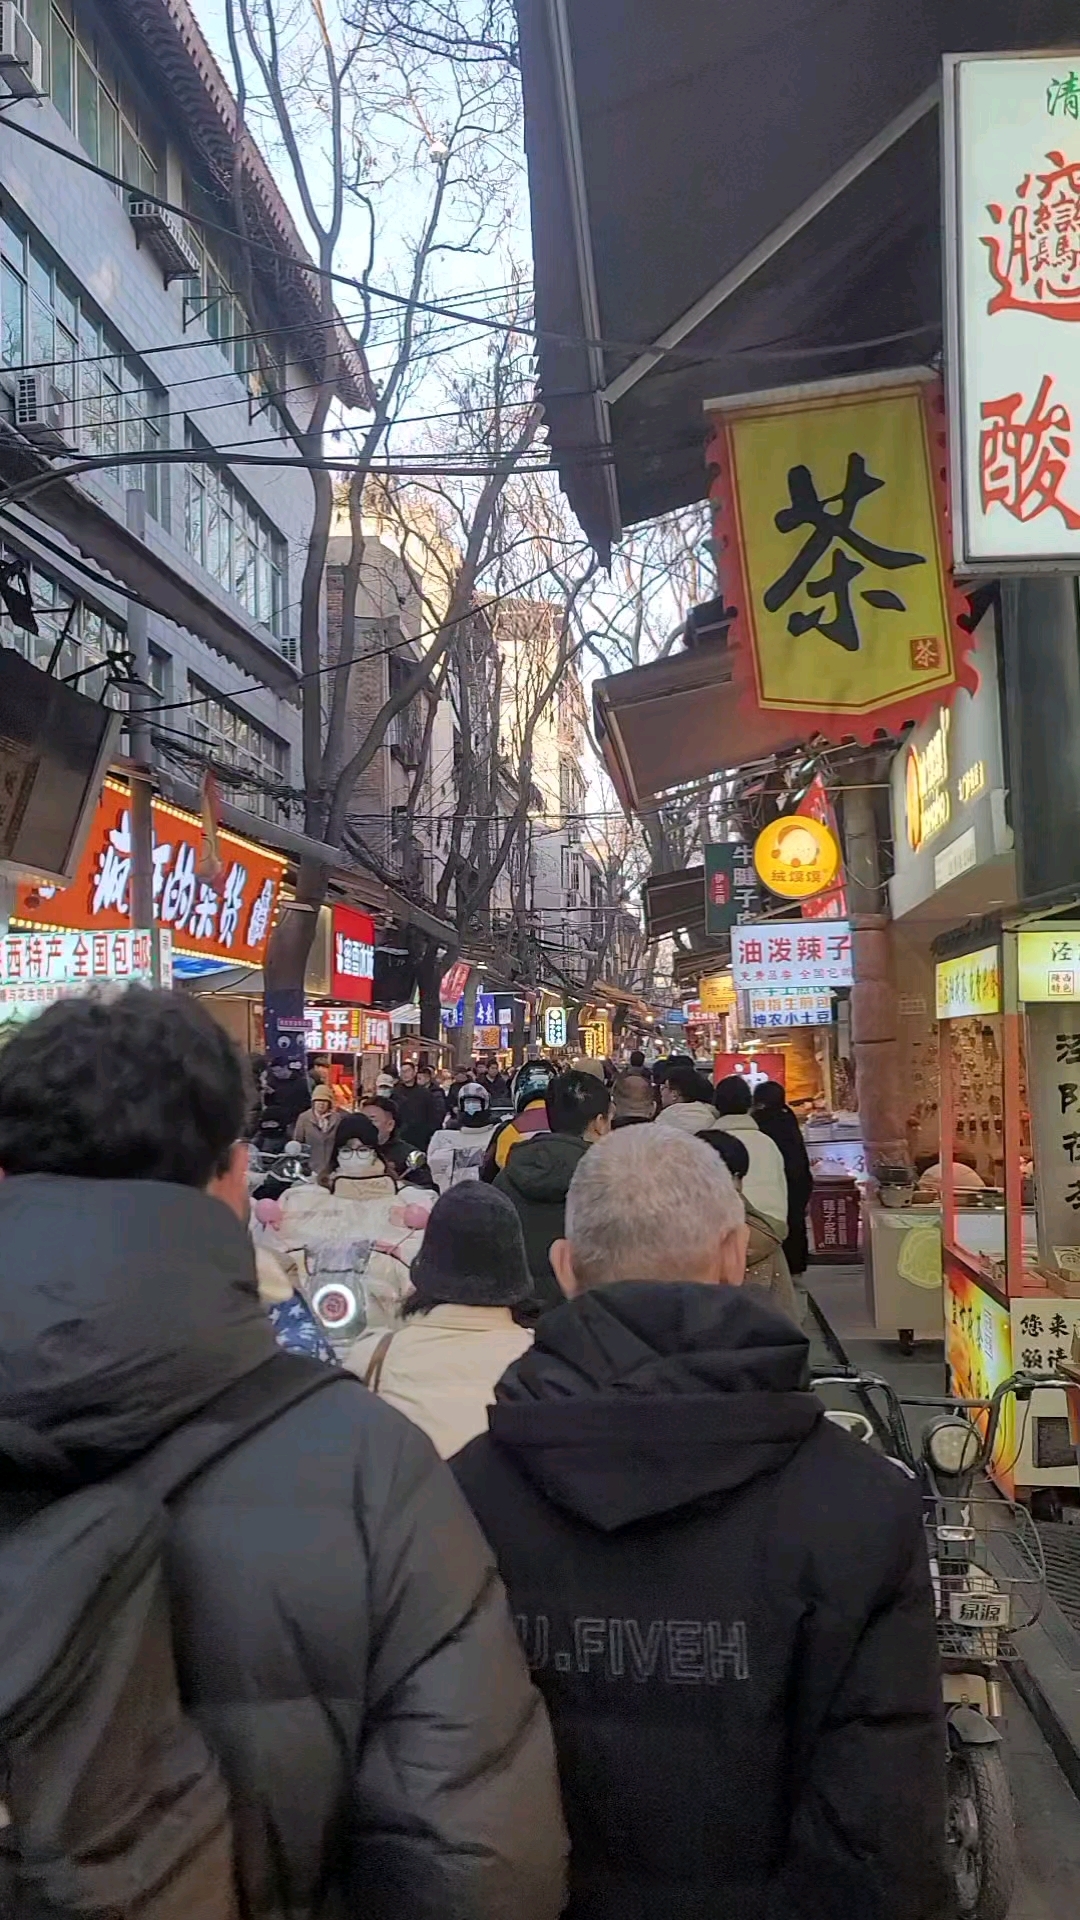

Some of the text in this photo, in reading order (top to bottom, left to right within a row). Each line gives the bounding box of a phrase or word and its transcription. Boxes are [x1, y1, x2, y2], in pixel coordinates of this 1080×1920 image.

[1047, 72, 1080, 120] 清
[979, 375, 1080, 530] 酸
[763, 452, 927, 652] 茶
[913, 639, 939, 668] 茶
[0, 938, 62, 978] 西特产
[73, 935, 151, 977] 全国包邮
[739, 935, 853, 965] 油泼辣子
[1052, 942, 1080, 961] 泾
[753, 1011, 830, 1027] 神农小土豆
[1020, 1313, 1070, 1337] 您来
